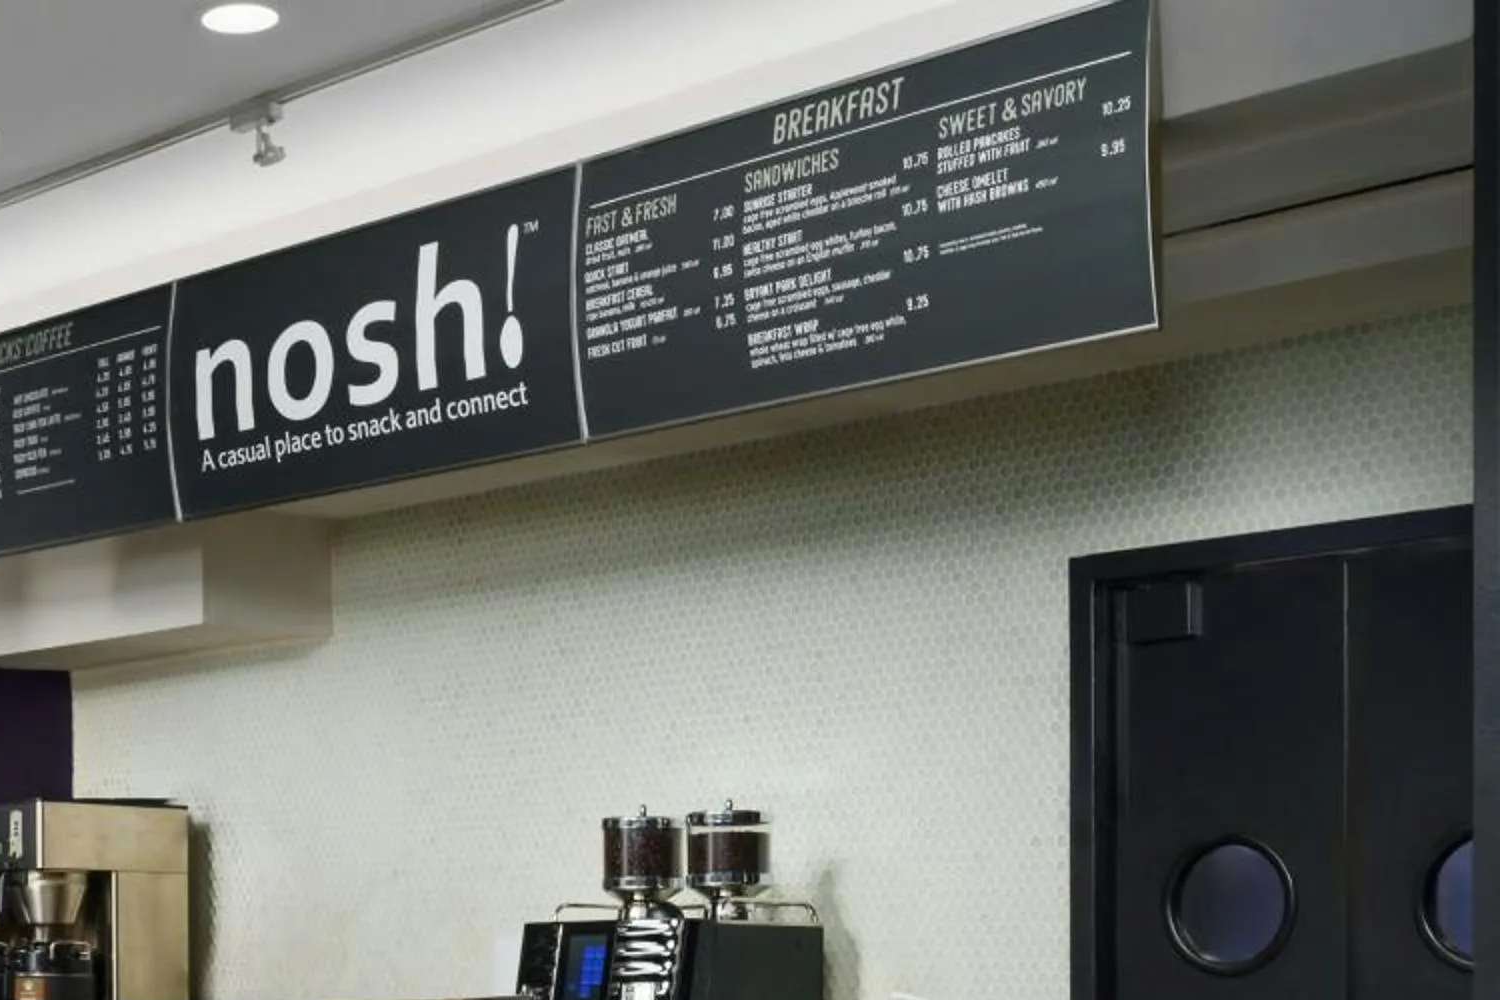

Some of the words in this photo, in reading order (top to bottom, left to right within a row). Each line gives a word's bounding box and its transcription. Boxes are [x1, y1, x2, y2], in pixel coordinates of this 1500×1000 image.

[772, 77, 904, 145] BREAKFAST
[938, 102, 997, 140] SWEET
[1002, 97, 1017, 122] &
[1021, 76, 1087, 117] SAVORY
[744, 148, 839, 193] SANDWICHES
[936, 152, 976, 175] STUFFED
[977, 145, 1002, 165] WITH
[971, 168, 1009, 191] OMELET
[586, 209, 617, 238] FAST
[621, 206, 633, 228] &
[635, 193, 677, 225] FRESH
[25, 322, 74, 359] COFFEE
[195, 223, 523, 441] nosh!
[523, 219, 539, 235] TM
[201, 448, 215, 473] A
[219, 435, 271, 468] casual
[275, 426, 322, 463] place
[325, 421, 344, 448] to
[348, 409, 402, 441] snack
[406, 397, 442, 430] and
[448, 381, 529, 420] connect
